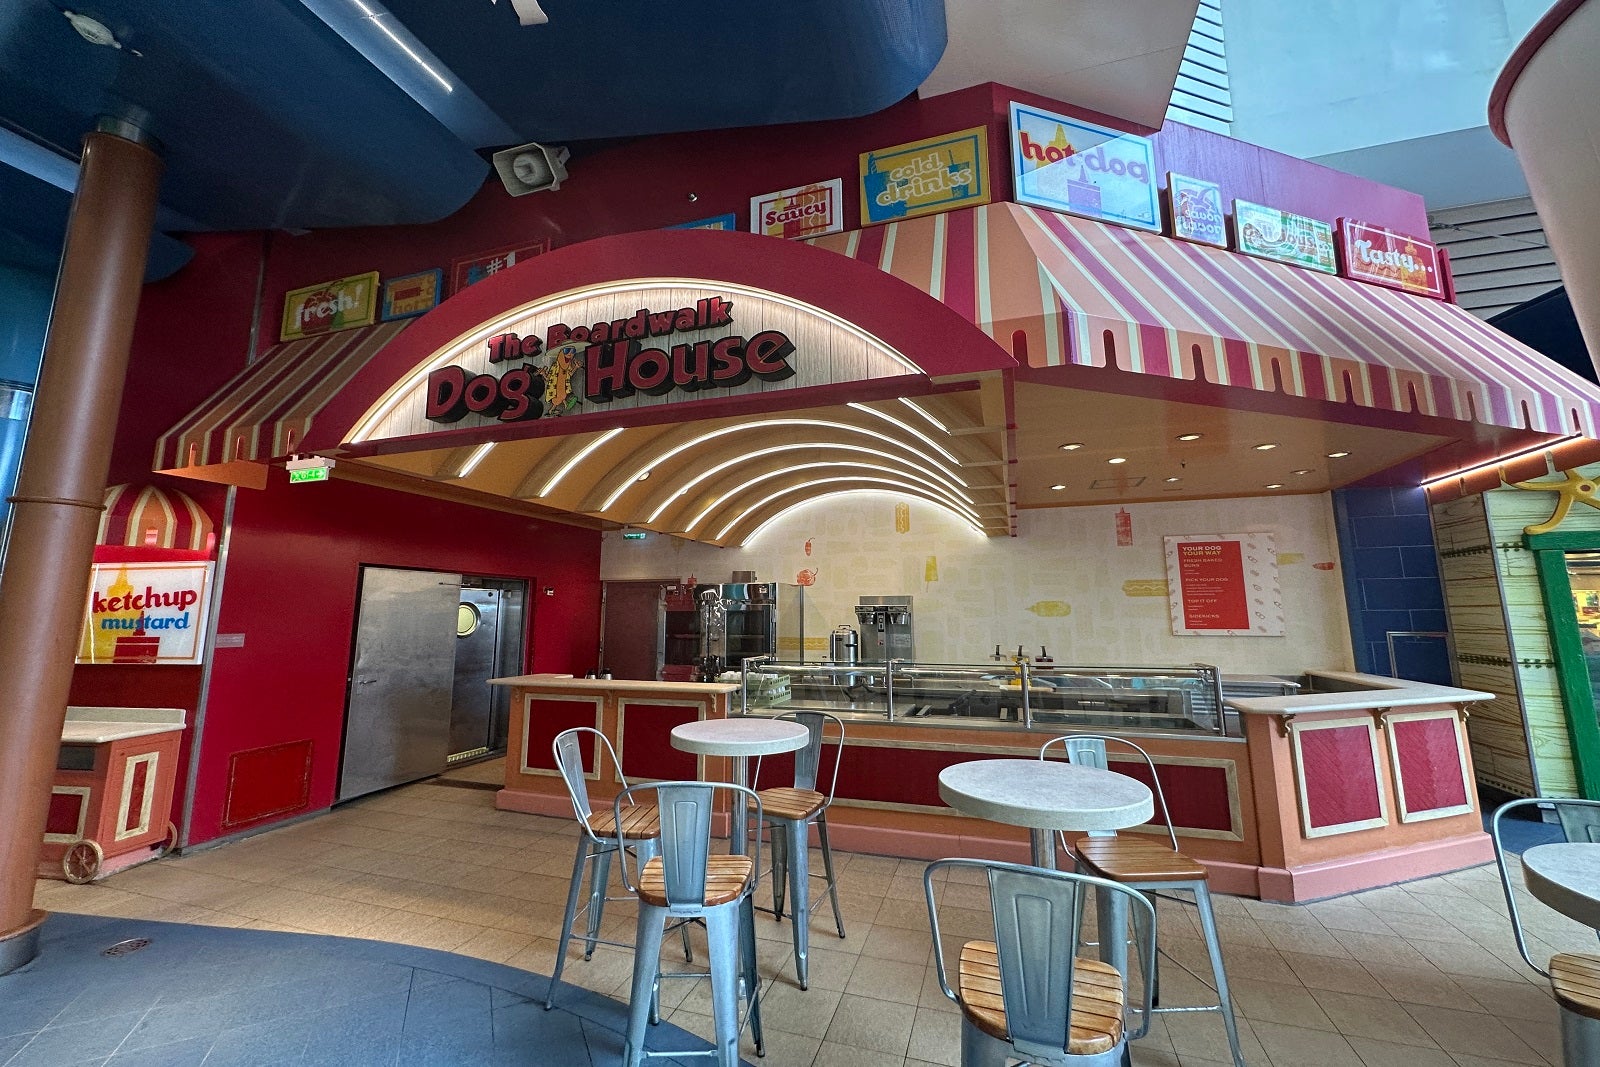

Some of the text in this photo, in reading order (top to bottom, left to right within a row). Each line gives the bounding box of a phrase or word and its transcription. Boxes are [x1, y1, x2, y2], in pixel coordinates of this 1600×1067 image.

[890, 152, 944, 182] cold
[1020, 131, 1151, 185] hot dog
[876, 168, 972, 206] drinks
[765, 201, 826, 226] Saucy
[486, 251, 516, 275] #1
[1355, 240, 1432, 273] Tasty...
[294, 284, 363, 329] fresh!
[488, 296, 734, 364] The Boardwalk
[426, 329, 797, 423] Dog House
[92, 586, 197, 613] ketchup
[102, 611, 190, 630] mustard
